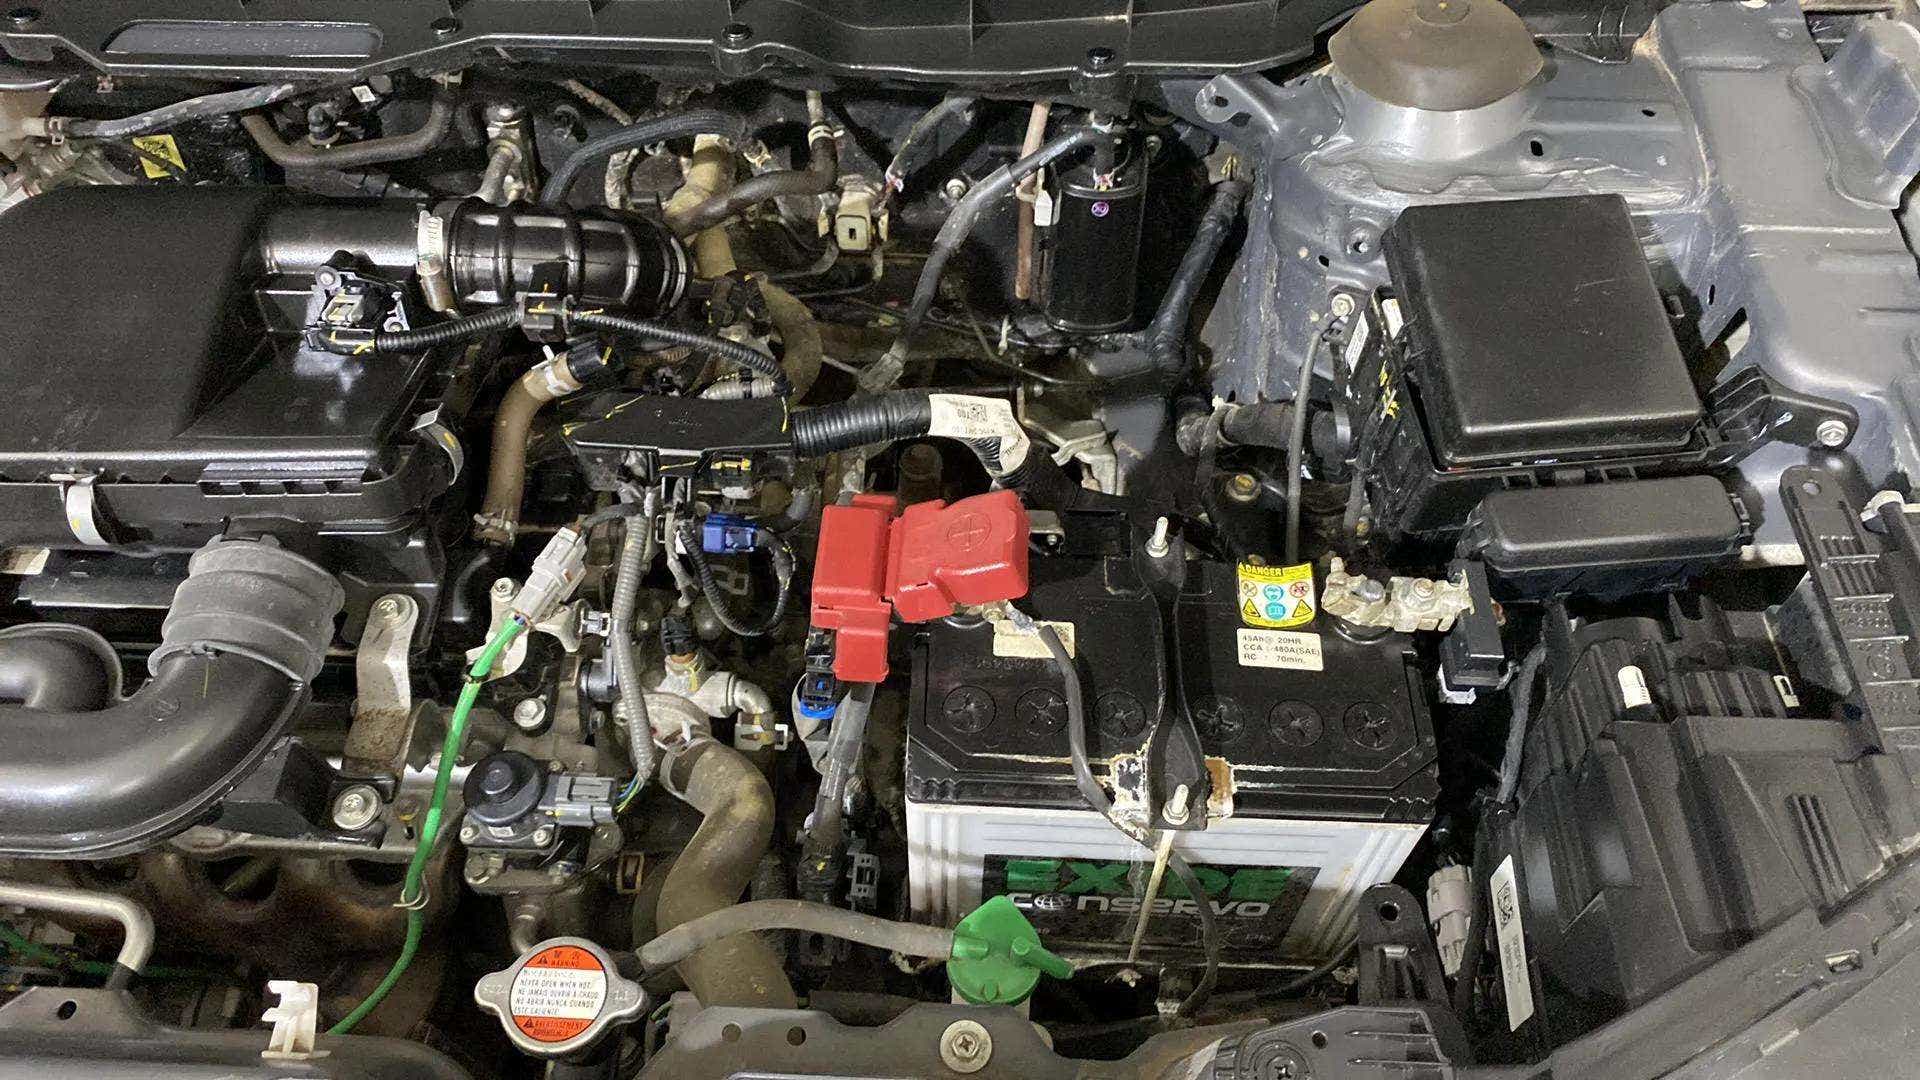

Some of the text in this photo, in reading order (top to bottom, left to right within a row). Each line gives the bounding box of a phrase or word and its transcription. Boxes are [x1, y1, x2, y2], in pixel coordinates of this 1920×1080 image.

[1246, 564, 1283, 577] DANGER
[1243, 653, 1257, 661] RC
[1005, 857, 1292, 902] EXDE
